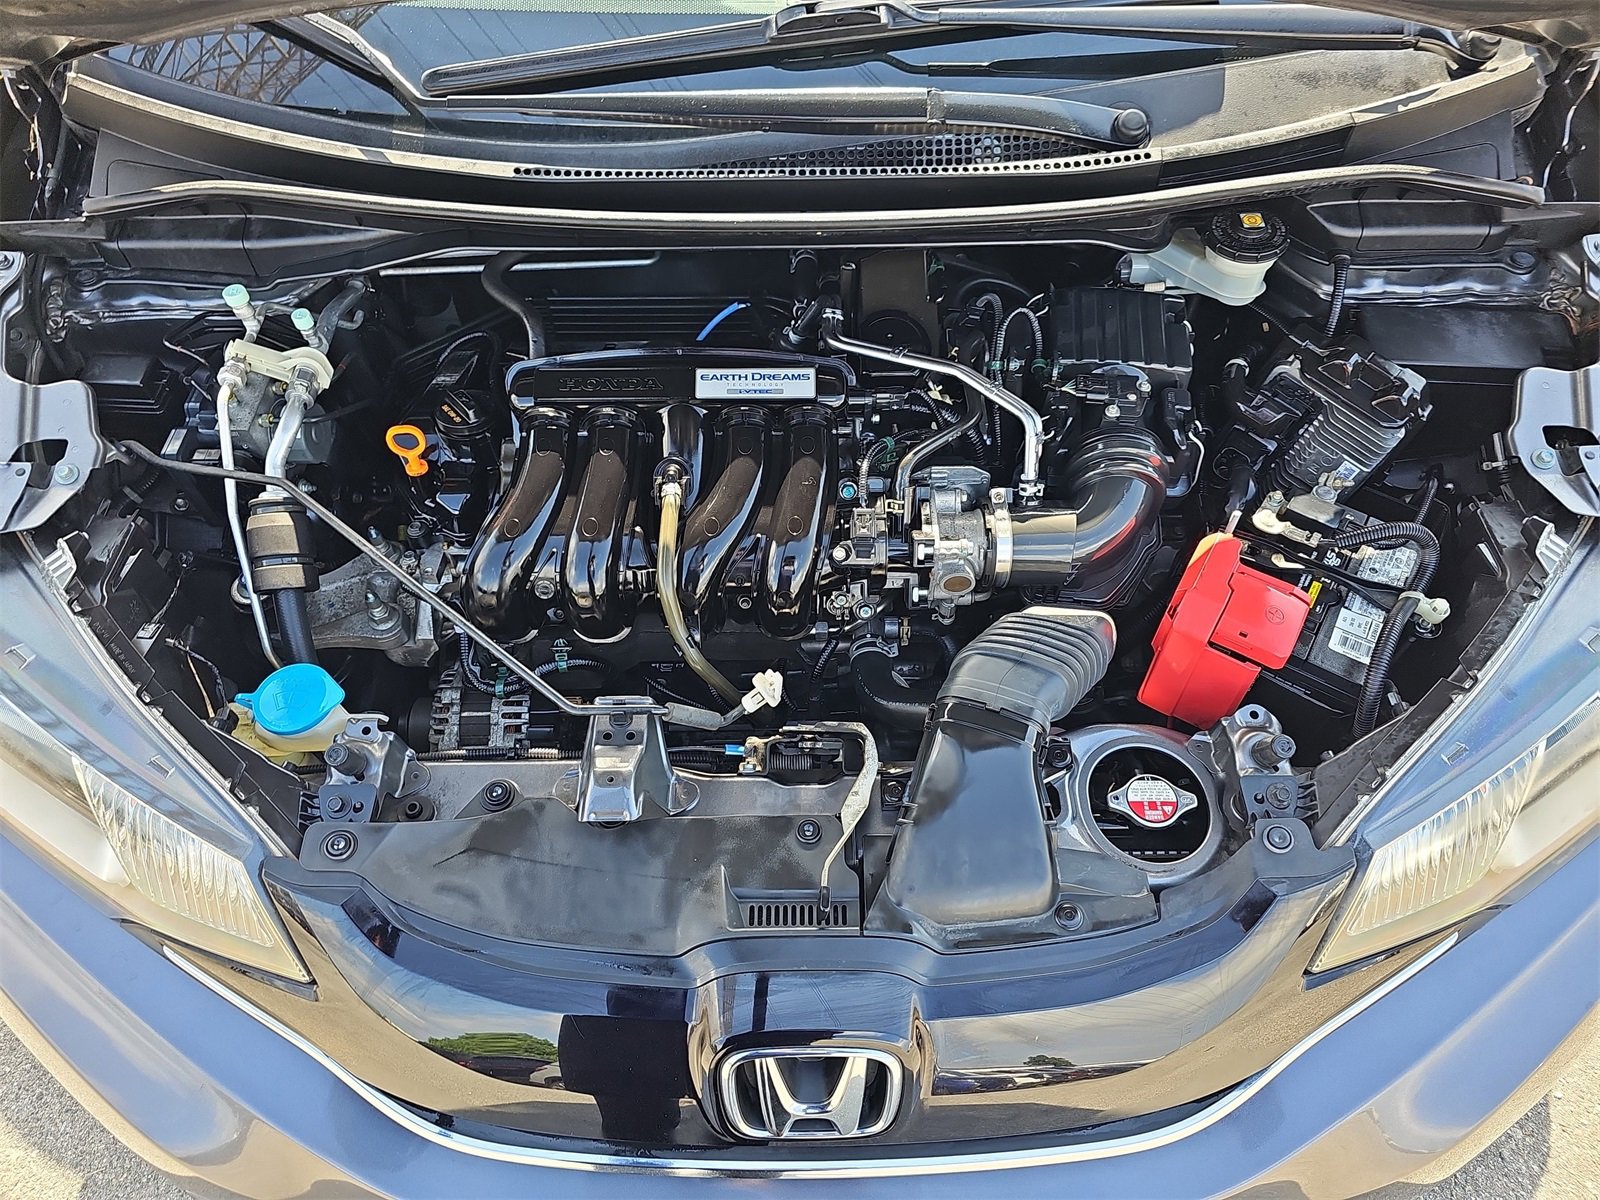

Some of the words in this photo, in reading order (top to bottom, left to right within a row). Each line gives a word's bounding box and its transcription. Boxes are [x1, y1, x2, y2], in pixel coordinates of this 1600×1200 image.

[700, 373, 748, 381] EARTH
[751, 372, 811, 381] DREAMS
[559, 377, 664, 391] HONDA
